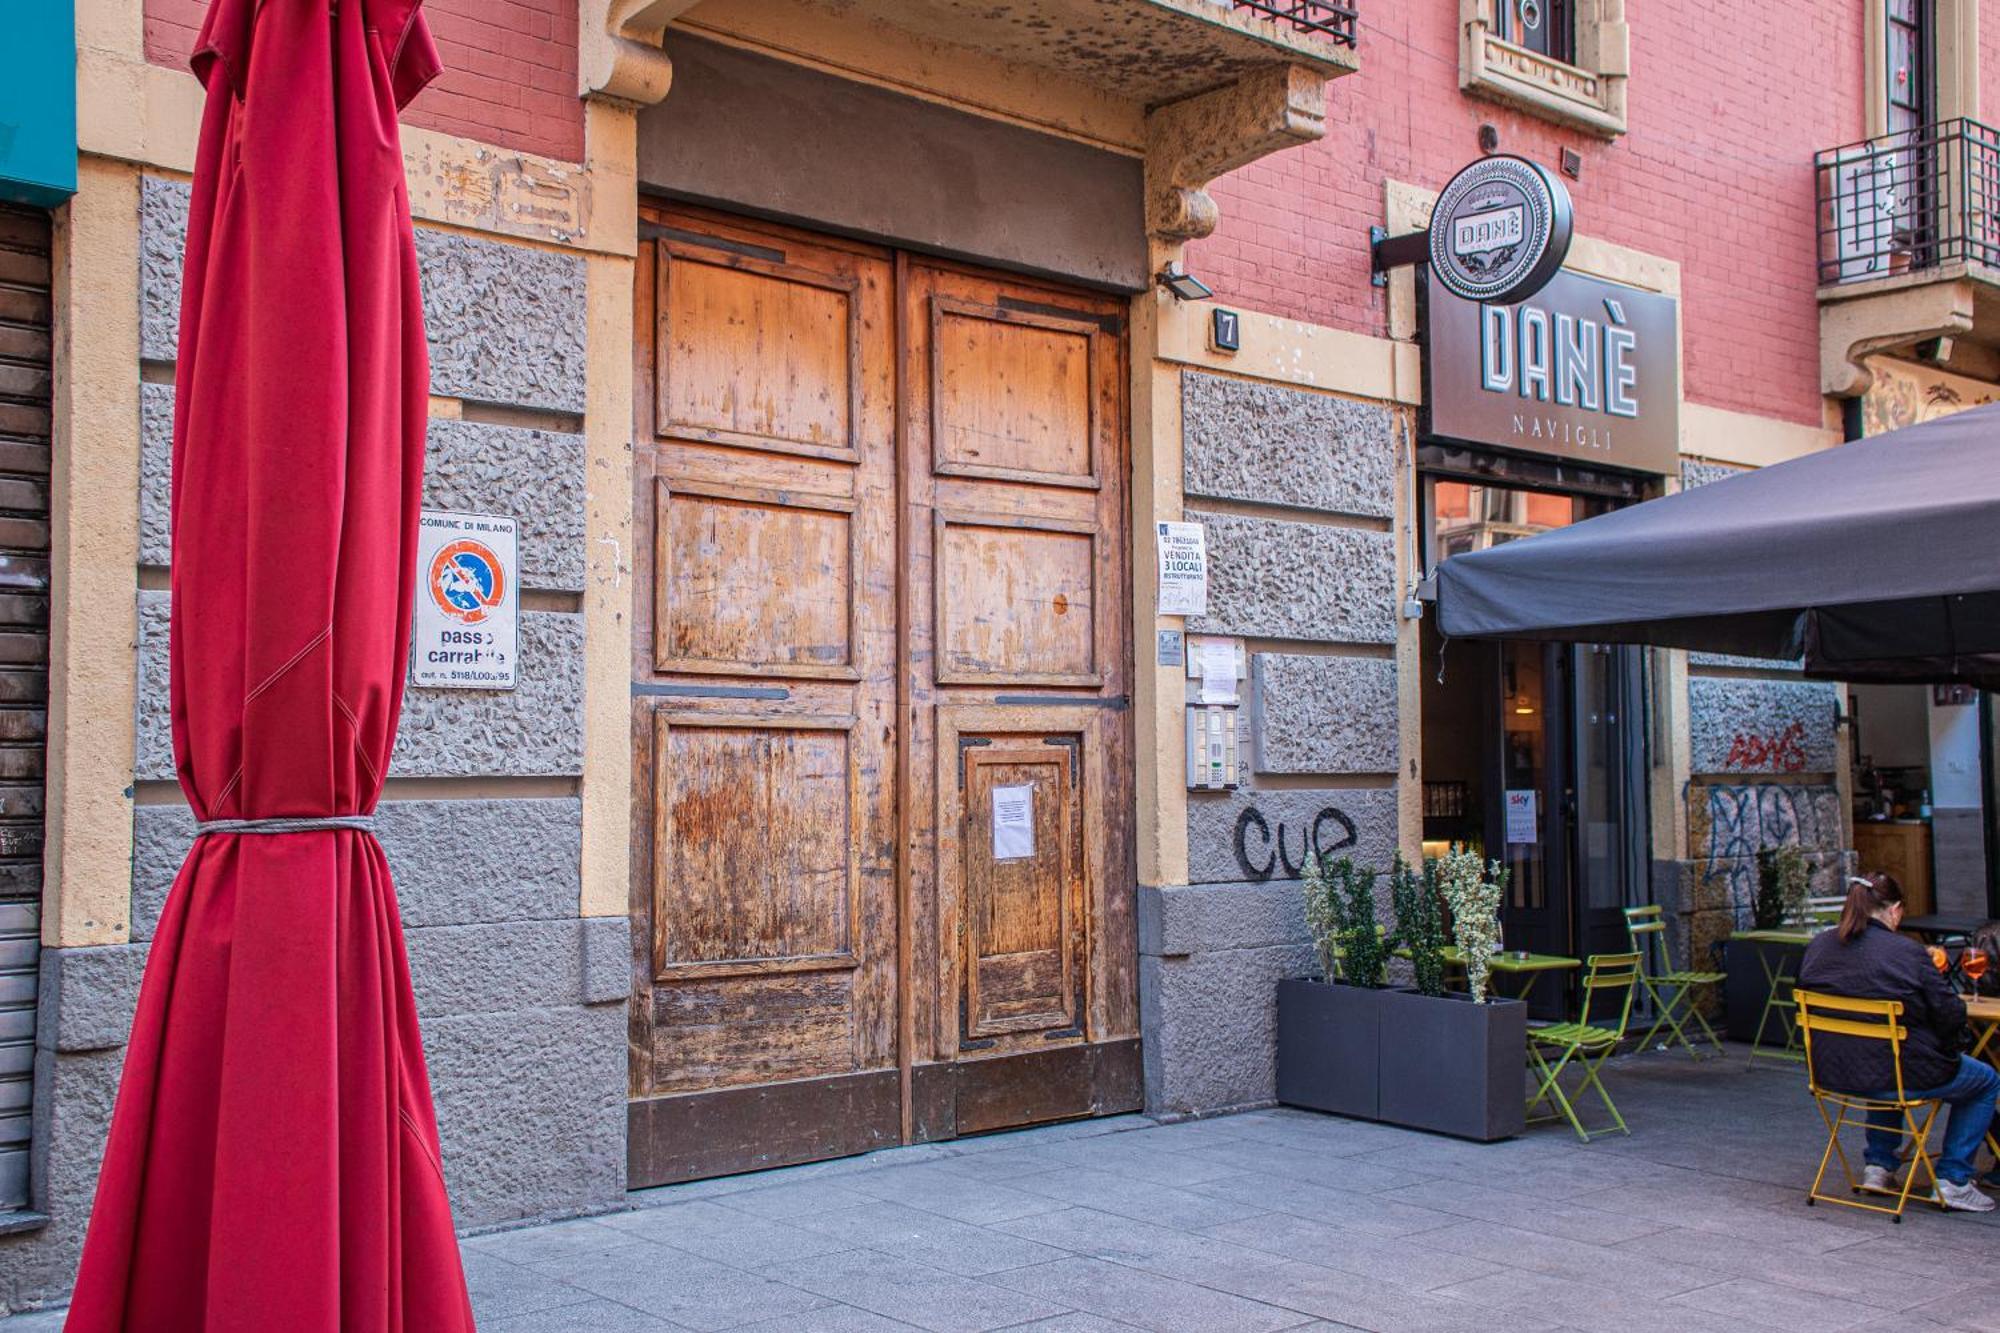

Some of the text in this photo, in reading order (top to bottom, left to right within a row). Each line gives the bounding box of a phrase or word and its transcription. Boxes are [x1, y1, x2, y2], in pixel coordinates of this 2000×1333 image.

[1222, 314, 1235, 343] 7
[1480, 298, 1638, 419] DANÈ
[1513, 414, 1612, 450] NAVIGLI
[420, 517, 513, 534] COMUNE DI MILANO
[1163, 551, 1201, 561] VENDITA
[1164, 561, 1203, 573] 3 LOCALI
[1510, 793, 1530, 807] sky
